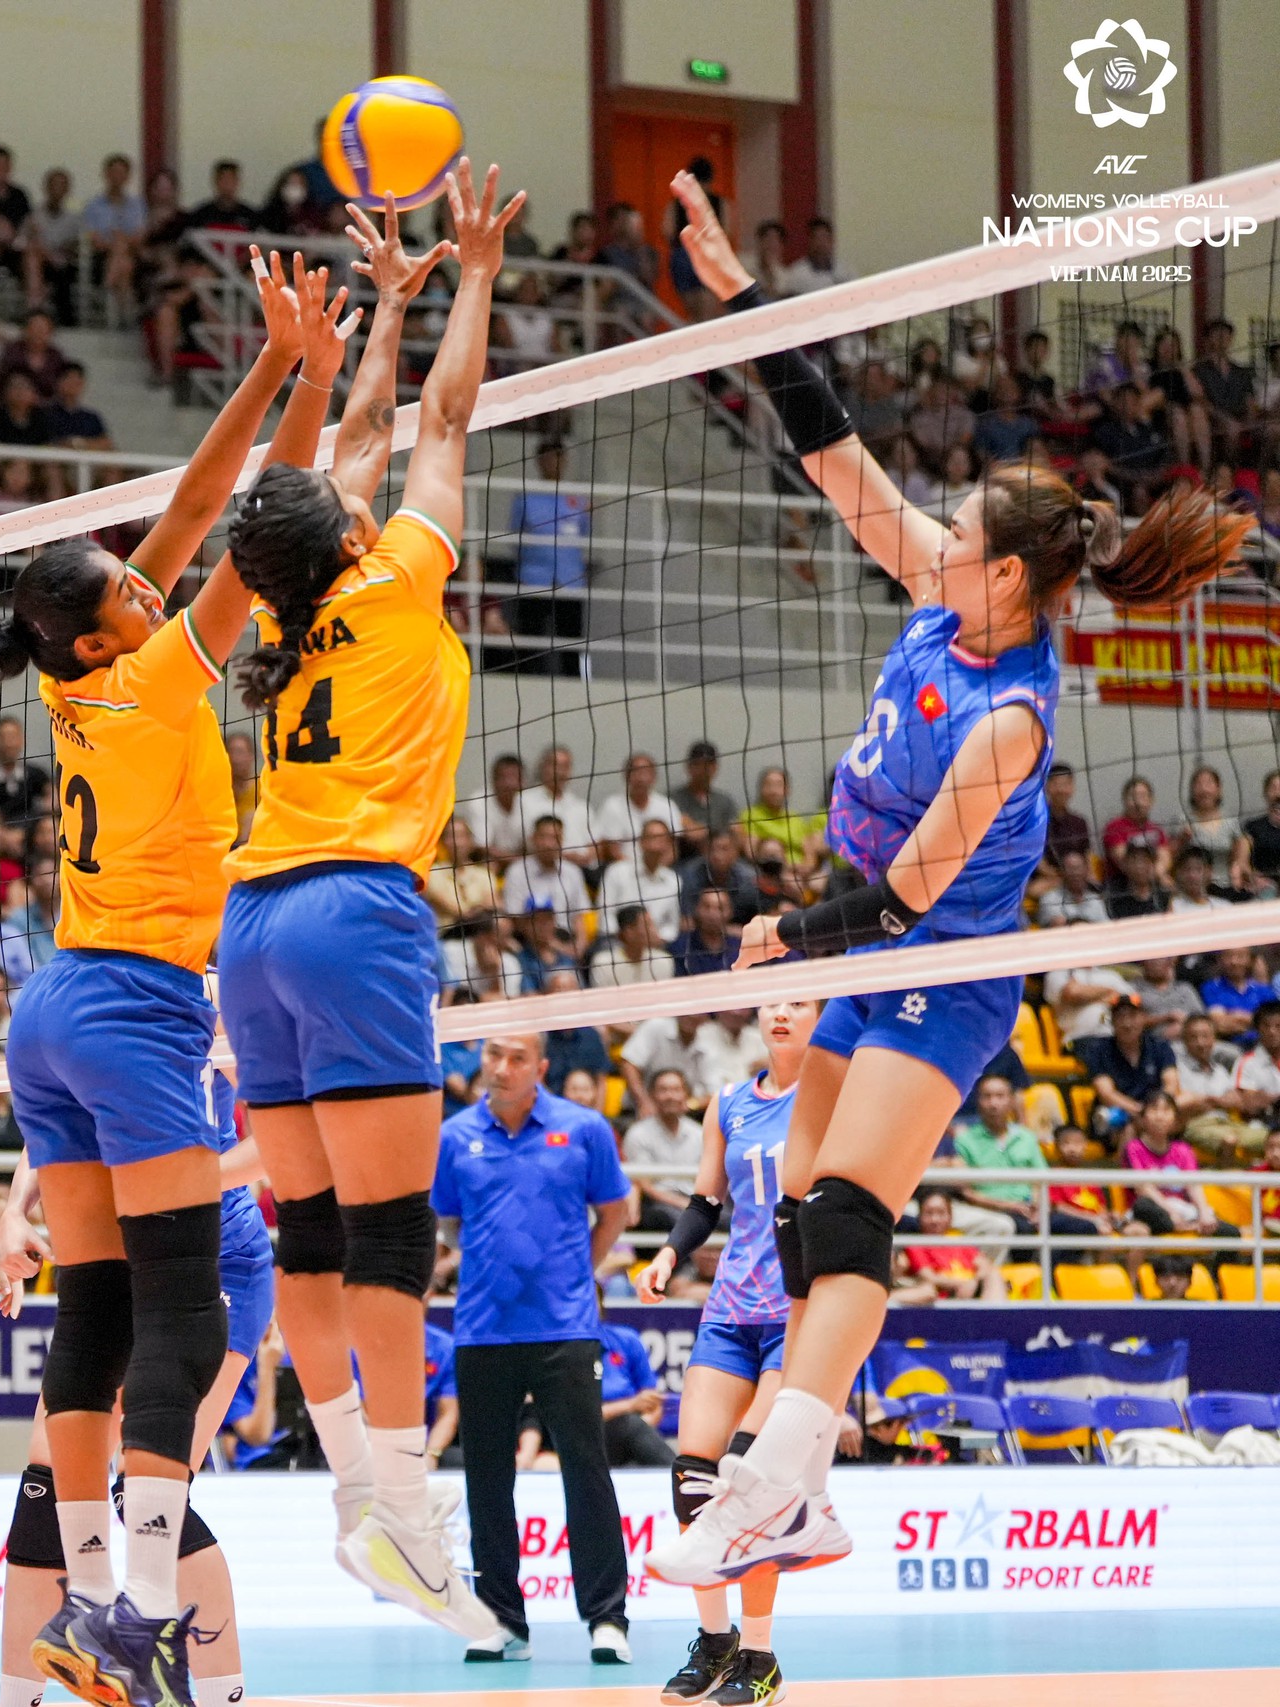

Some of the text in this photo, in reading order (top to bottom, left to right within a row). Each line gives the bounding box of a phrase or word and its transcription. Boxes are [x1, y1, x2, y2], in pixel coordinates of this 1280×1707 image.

[742, 1141, 785, 1206] 11
[1002, 1565, 1155, 1590] SPORT CARE
